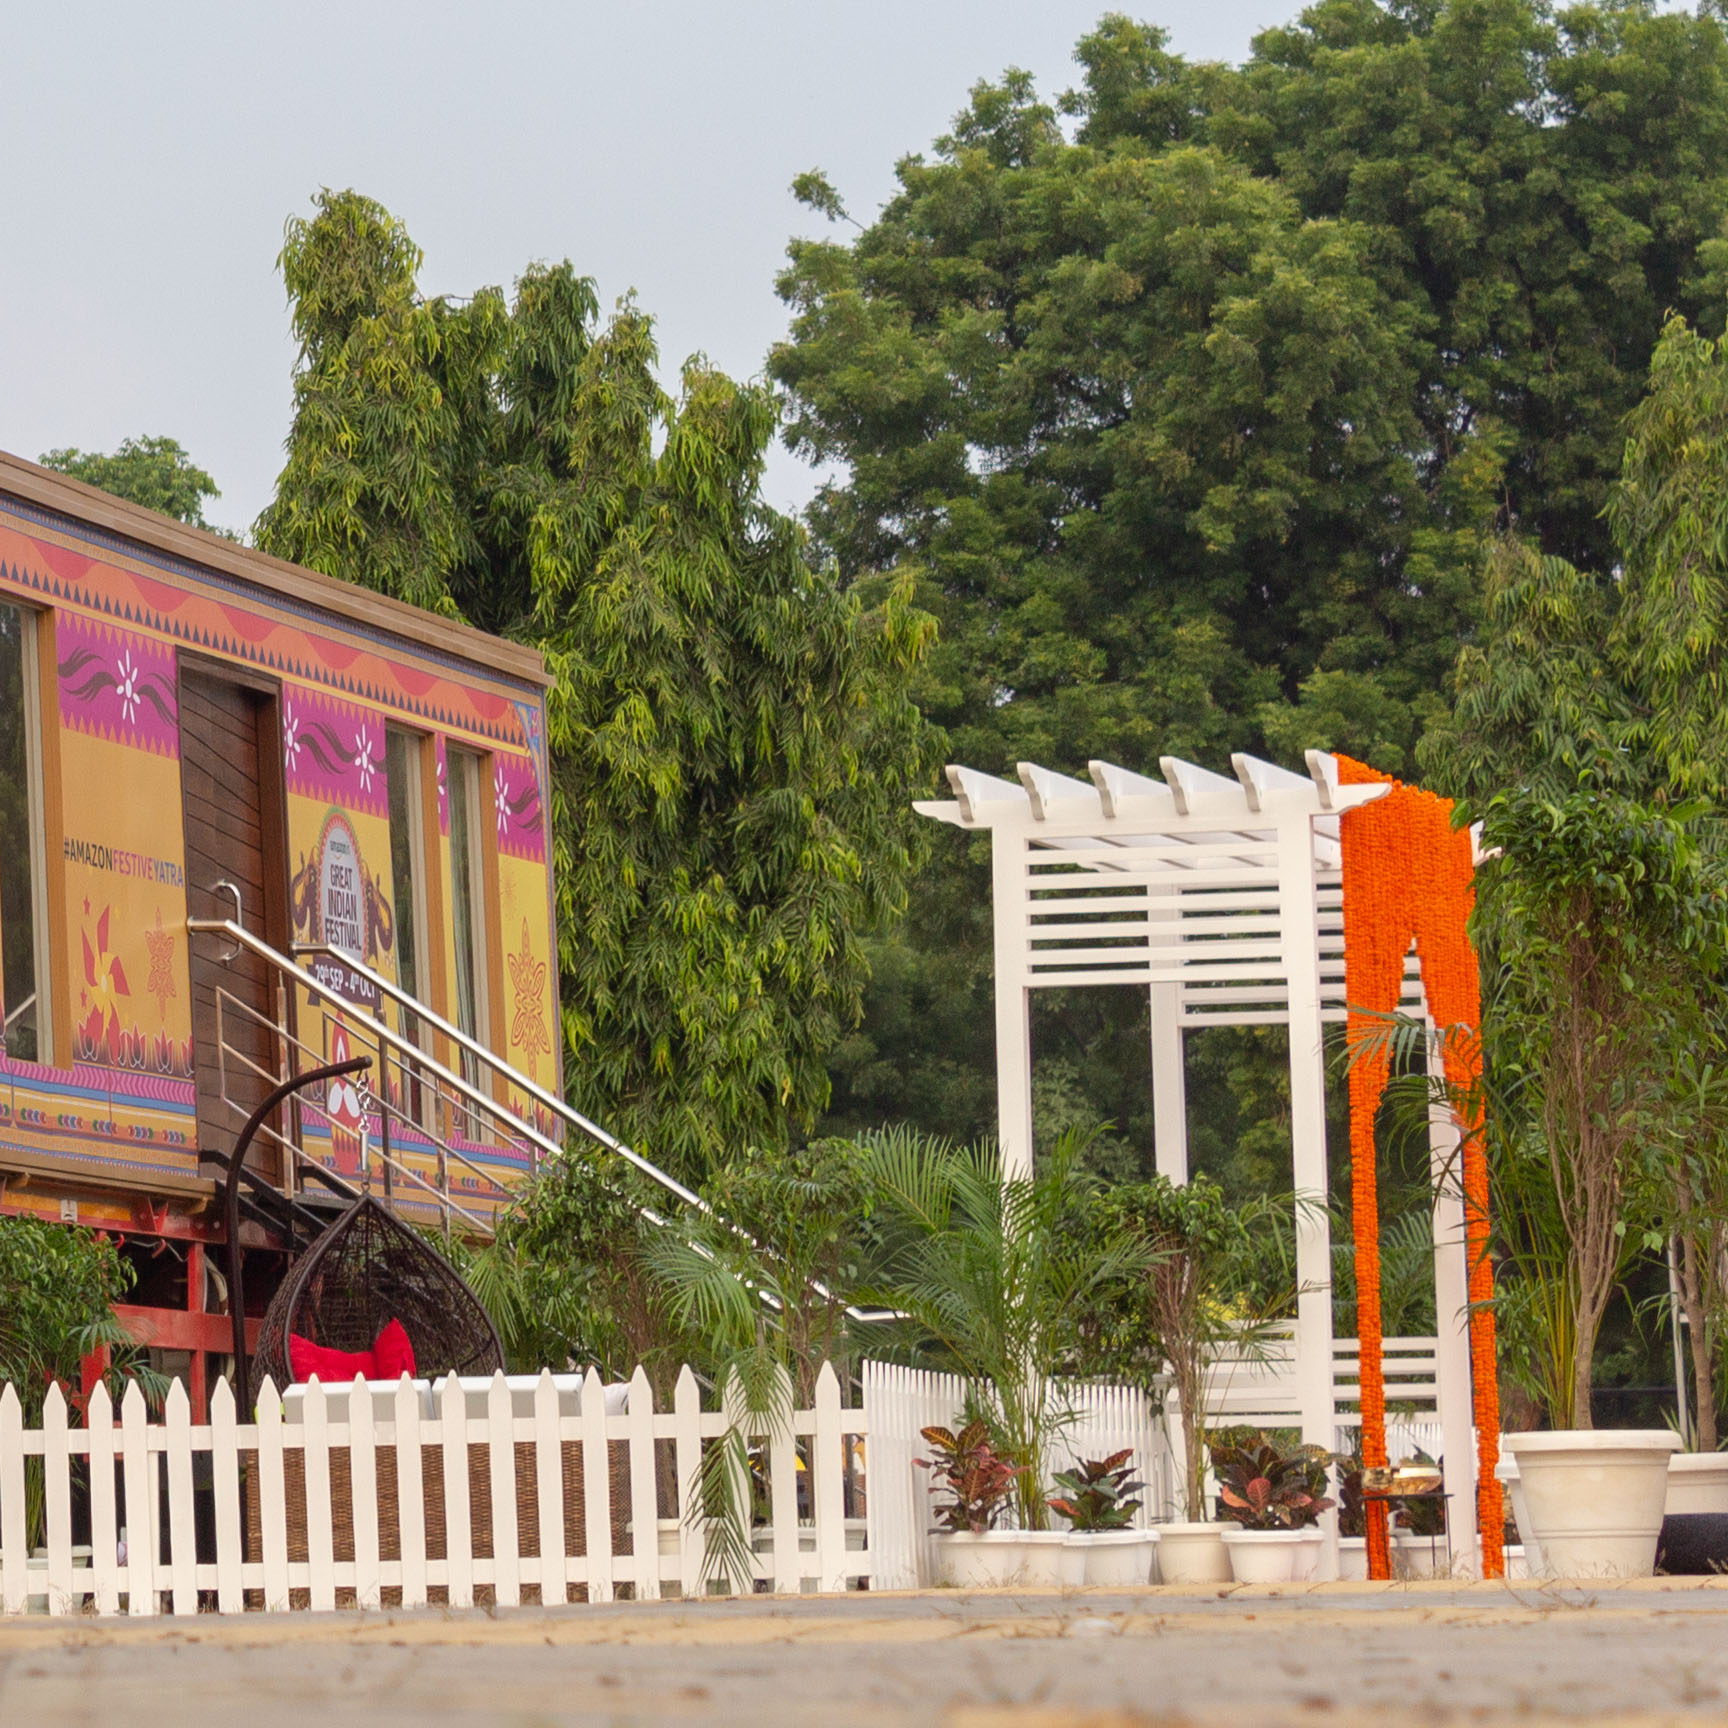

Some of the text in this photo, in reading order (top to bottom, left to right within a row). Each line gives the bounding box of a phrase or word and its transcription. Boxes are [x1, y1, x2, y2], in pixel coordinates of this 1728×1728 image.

[64, 836, 183, 888] #AMAZONFESTIVEYATRA
[330, 864, 352, 891] GREAT
[328, 888, 357, 922] INDIAN
[325, 918, 362, 951] FESTIVAL
[330, 967, 343, 991] SEP
